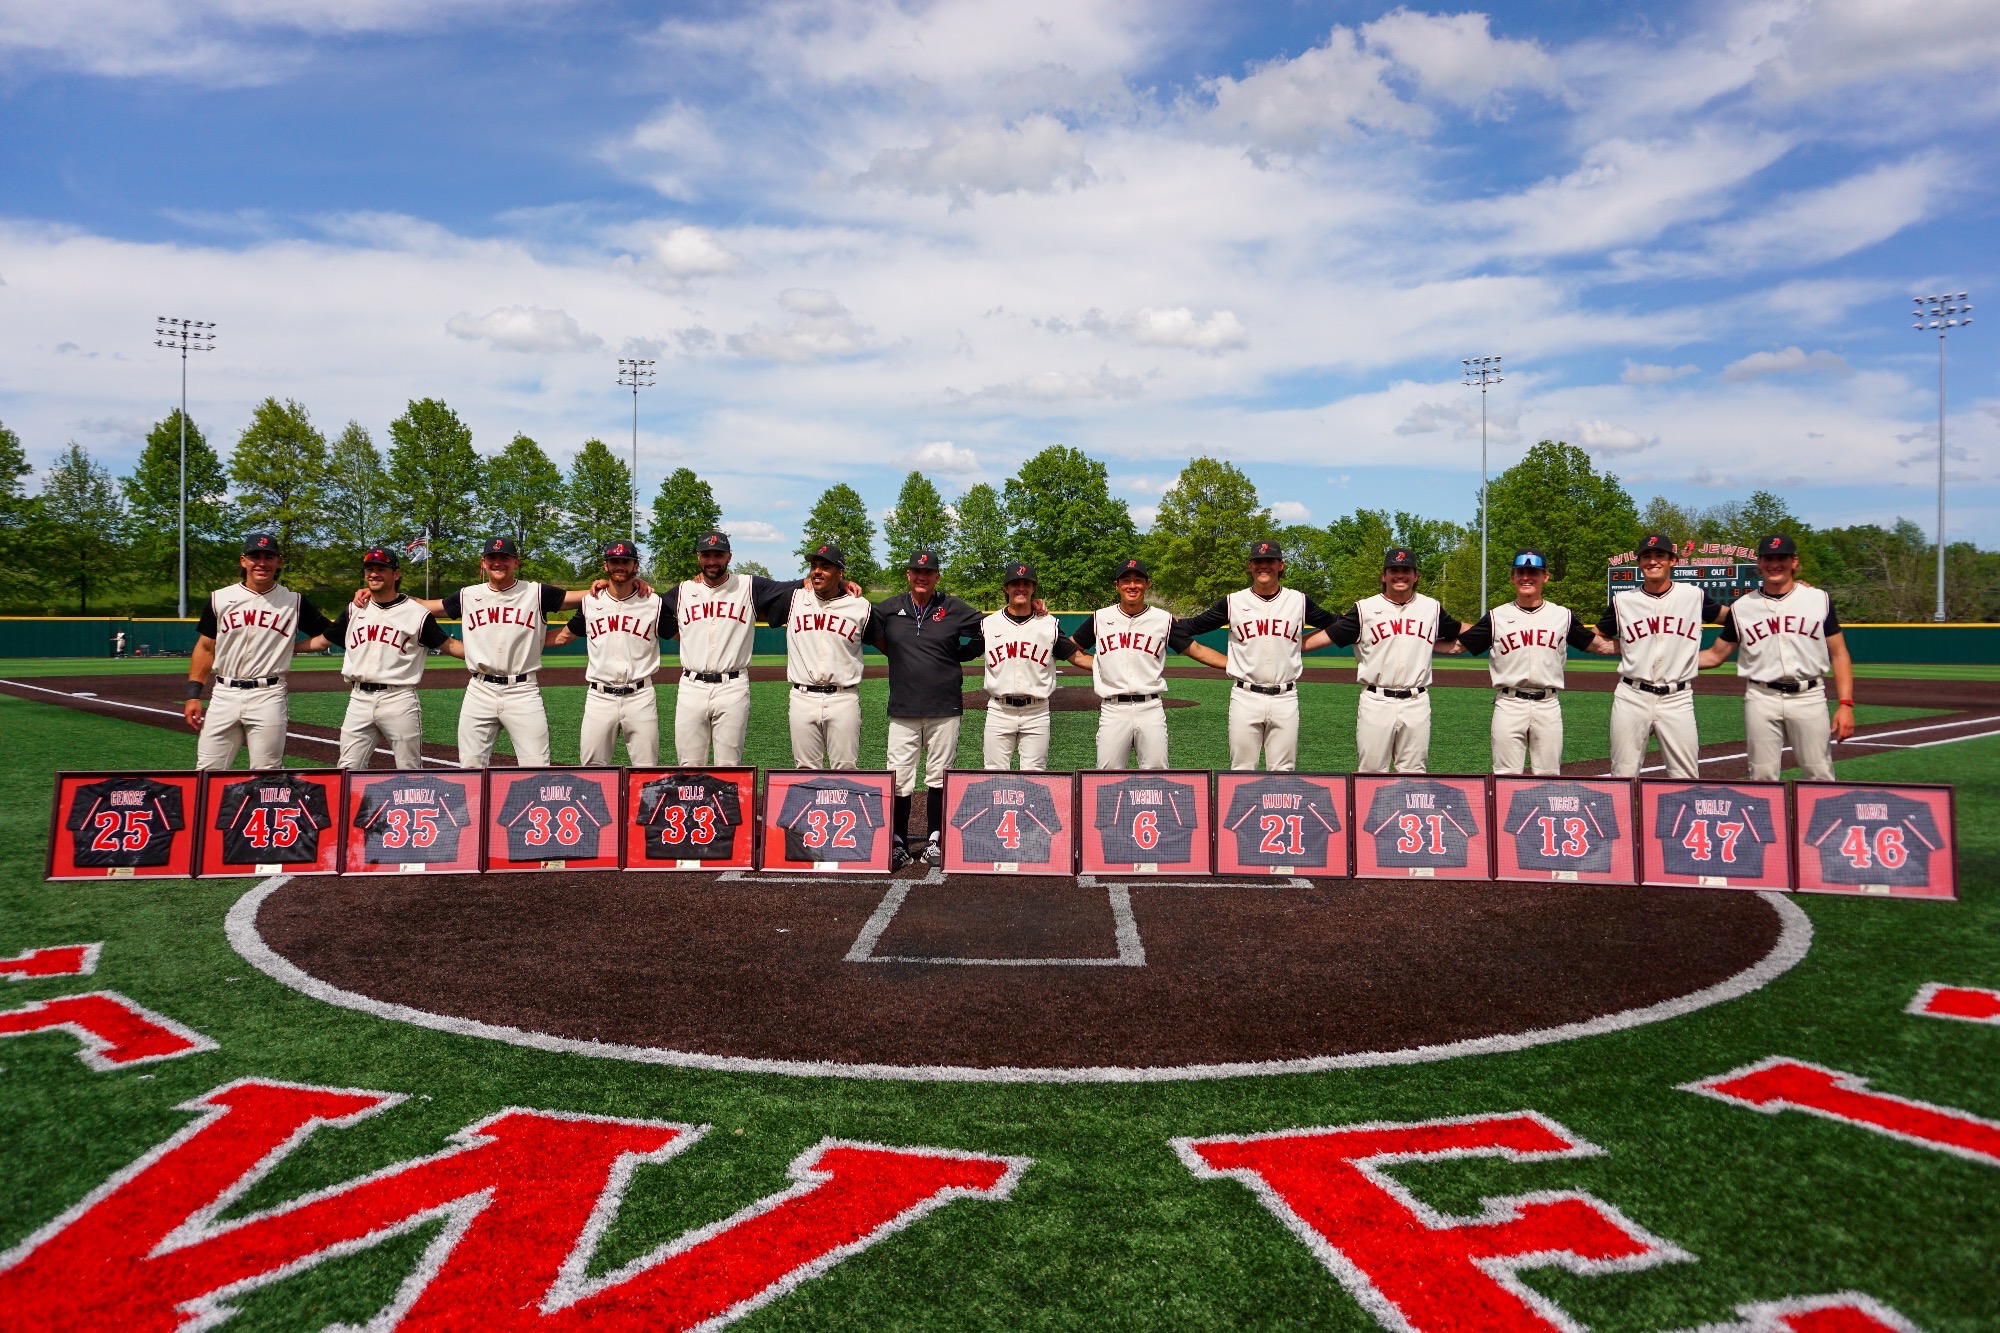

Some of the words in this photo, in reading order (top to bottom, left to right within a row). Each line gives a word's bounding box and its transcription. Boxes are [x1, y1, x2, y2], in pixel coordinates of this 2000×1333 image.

[1698, 543, 1758, 560] JEWEL
[1673, 569, 1698, 577] STRIKE
[1711, 568, 1725, 576] OUT
[221, 609, 290, 638] JEWELL
[467, 606, 536, 632] JEWELL
[683, 600, 748, 626] JEWELL
[349, 624, 411, 655] JEWELL
[589, 613, 653, 643] JEWELL
[794, 613, 859, 644] JEWELL
[1236, 618, 1300, 643] JEWELL
[1370, 618, 1434, 645] JEWELL
[1624, 615, 1698, 645] JEWELL
[1745, 615, 1821, 647] JEWELL
[988, 640, 1050, 669] JEWELL
[1099, 631, 1164, 660] JEWELL
[110, 790, 147, 806] GEORGE
[259, 787, 292, 803] TAYLOR
[392, 788, 436, 805] BLUNDELL
[540, 785, 573, 802] CAUDLE
[677, 785, 705, 801] WELLS
[992, 789, 1025, 806] BIES
[1262, 793, 1303, 810] HUNT
[1405, 793, 1436, 809] LITTLE
[1548, 796, 1580, 812] TIGGES
[1694, 799, 1732, 816] CURLEY
[91, 810, 153, 852] 25
[243, 807, 302, 849] 45
[382, 808, 441, 849] 35
[525, 806, 584, 846] 38
[662, 805, 718, 846] 33
[803, 809, 857, 848] 32
[995, 809, 1021, 849] 4
[1131, 809, 1162, 850] 6
[1259, 814, 1306, 855] 21
[1397, 813, 1447, 855] 31
[1537, 816, 1591, 858] 13
[1682, 818, 1745, 864] 47
[1838, 825, 1910, 869] 46
